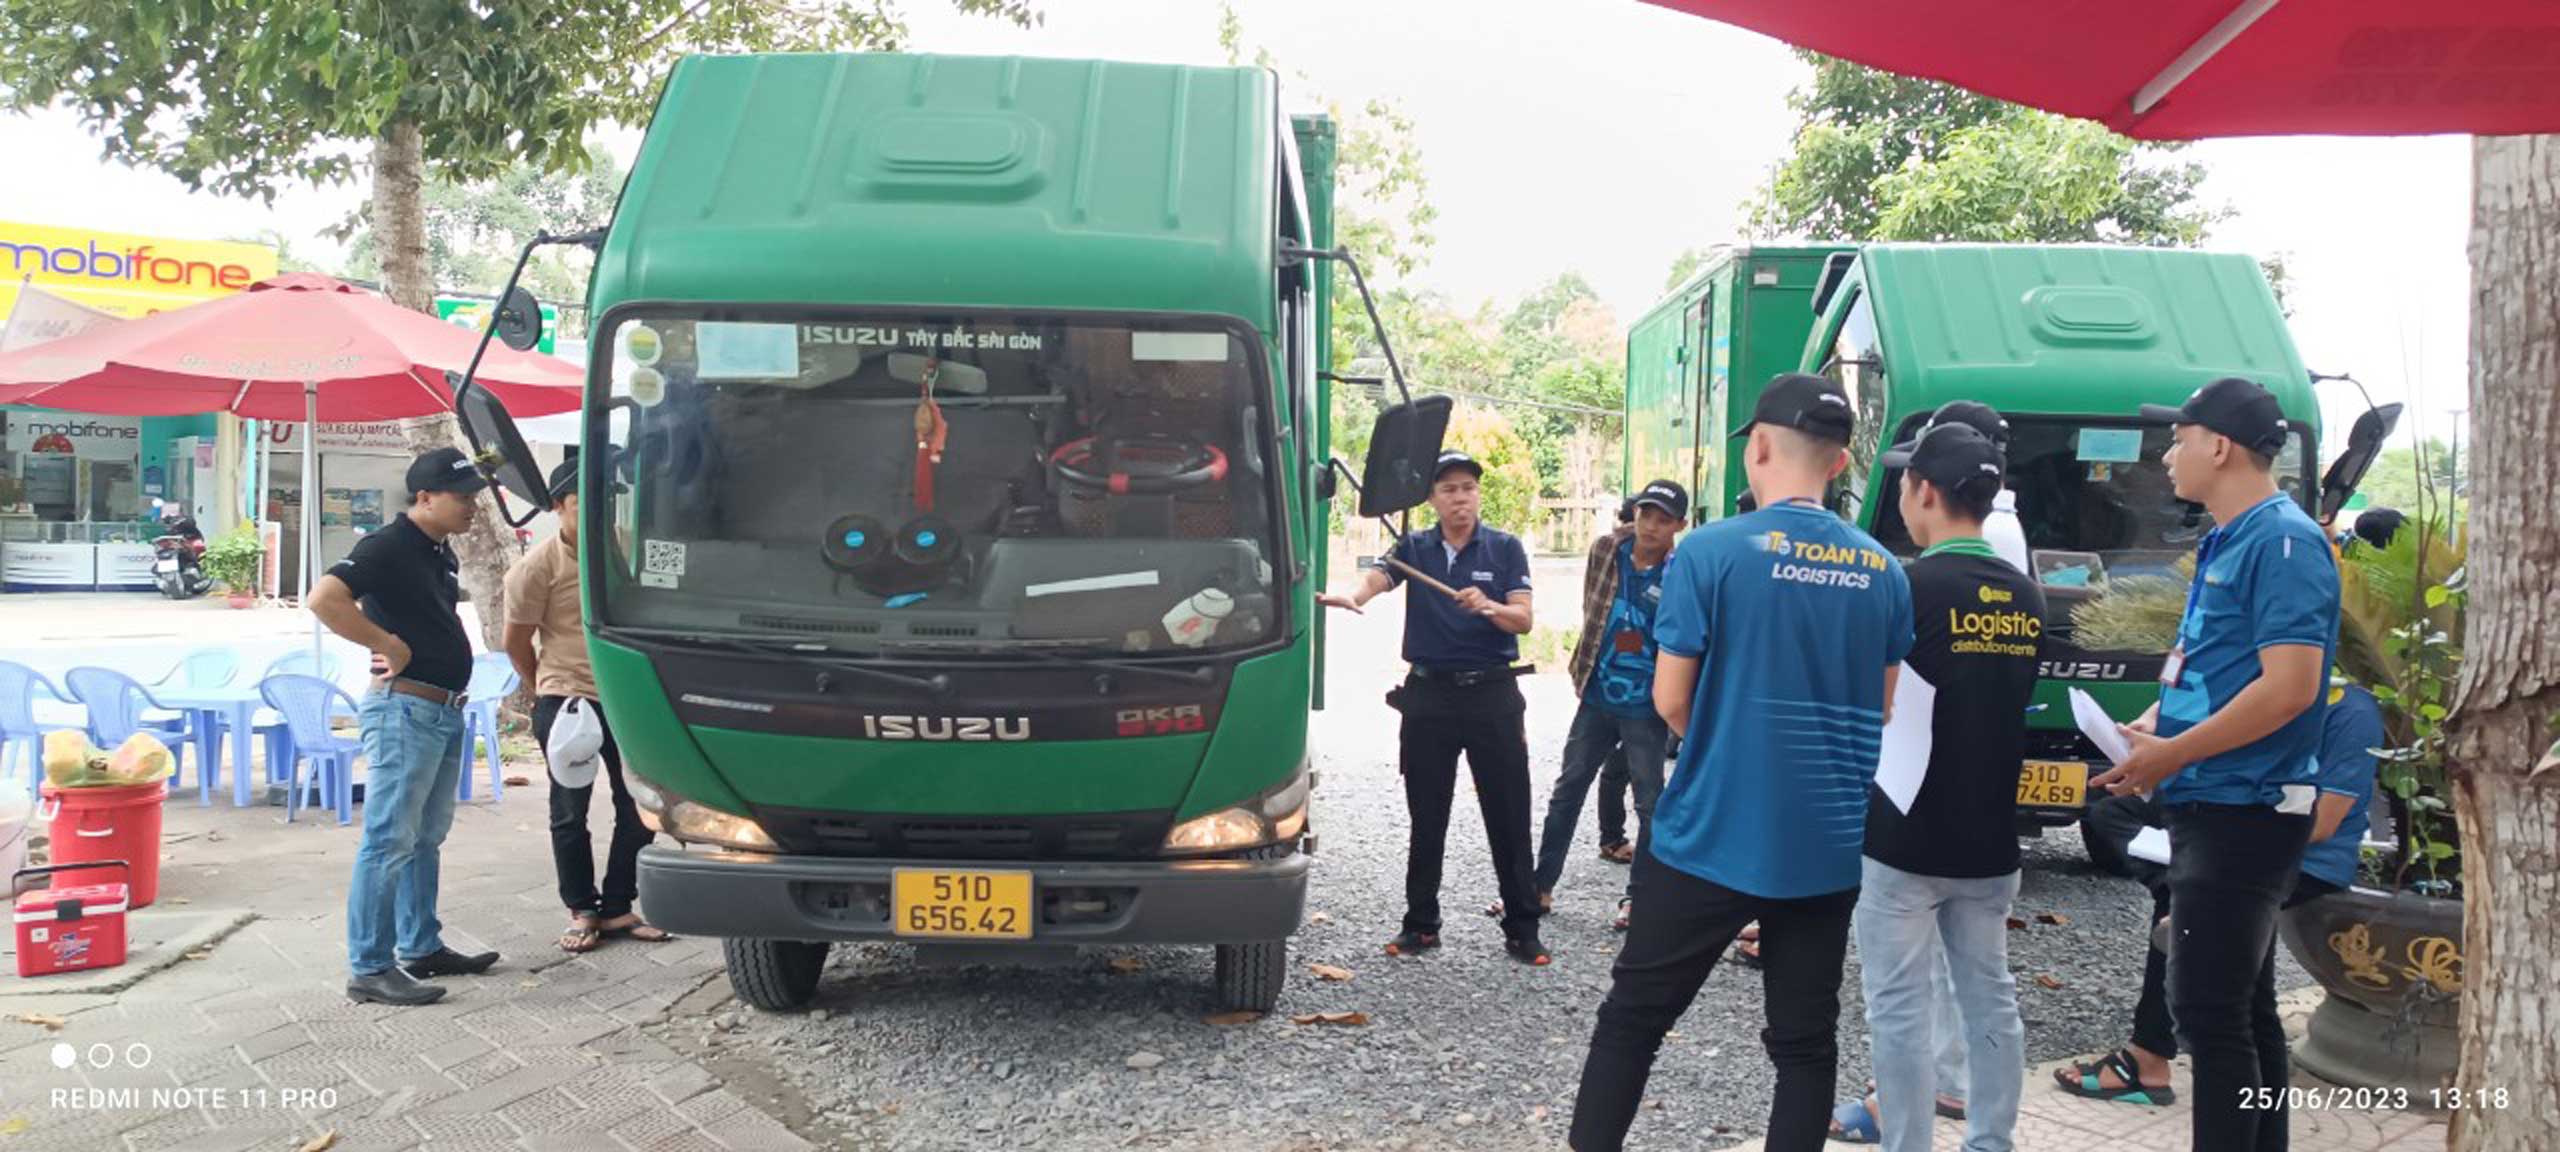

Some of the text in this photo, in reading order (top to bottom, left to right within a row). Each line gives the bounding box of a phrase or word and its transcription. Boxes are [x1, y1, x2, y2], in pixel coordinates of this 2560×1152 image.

[0, 240, 250, 289] mobifone
[803, 326, 899, 346] ISUZU
[906, 329, 938, 347] TÂY
[978, 330, 1004, 349] SÀI
[1009, 330, 1042, 350] GÒN
[28, 420, 138, 439] mobifone
[1794, 541, 1856, 565] TOÀN
[1772, 563, 1871, 589] LOGISTICS
[1950, 607, 2041, 640] Logistic
[2038, 661, 2126, 680] SUZU
[864, 714, 1031, 741] ISUZU
[2018, 784, 2075, 804] 74.69
[934, 875, 992, 902] 51D
[910, 906, 1016, 933] 656.42
